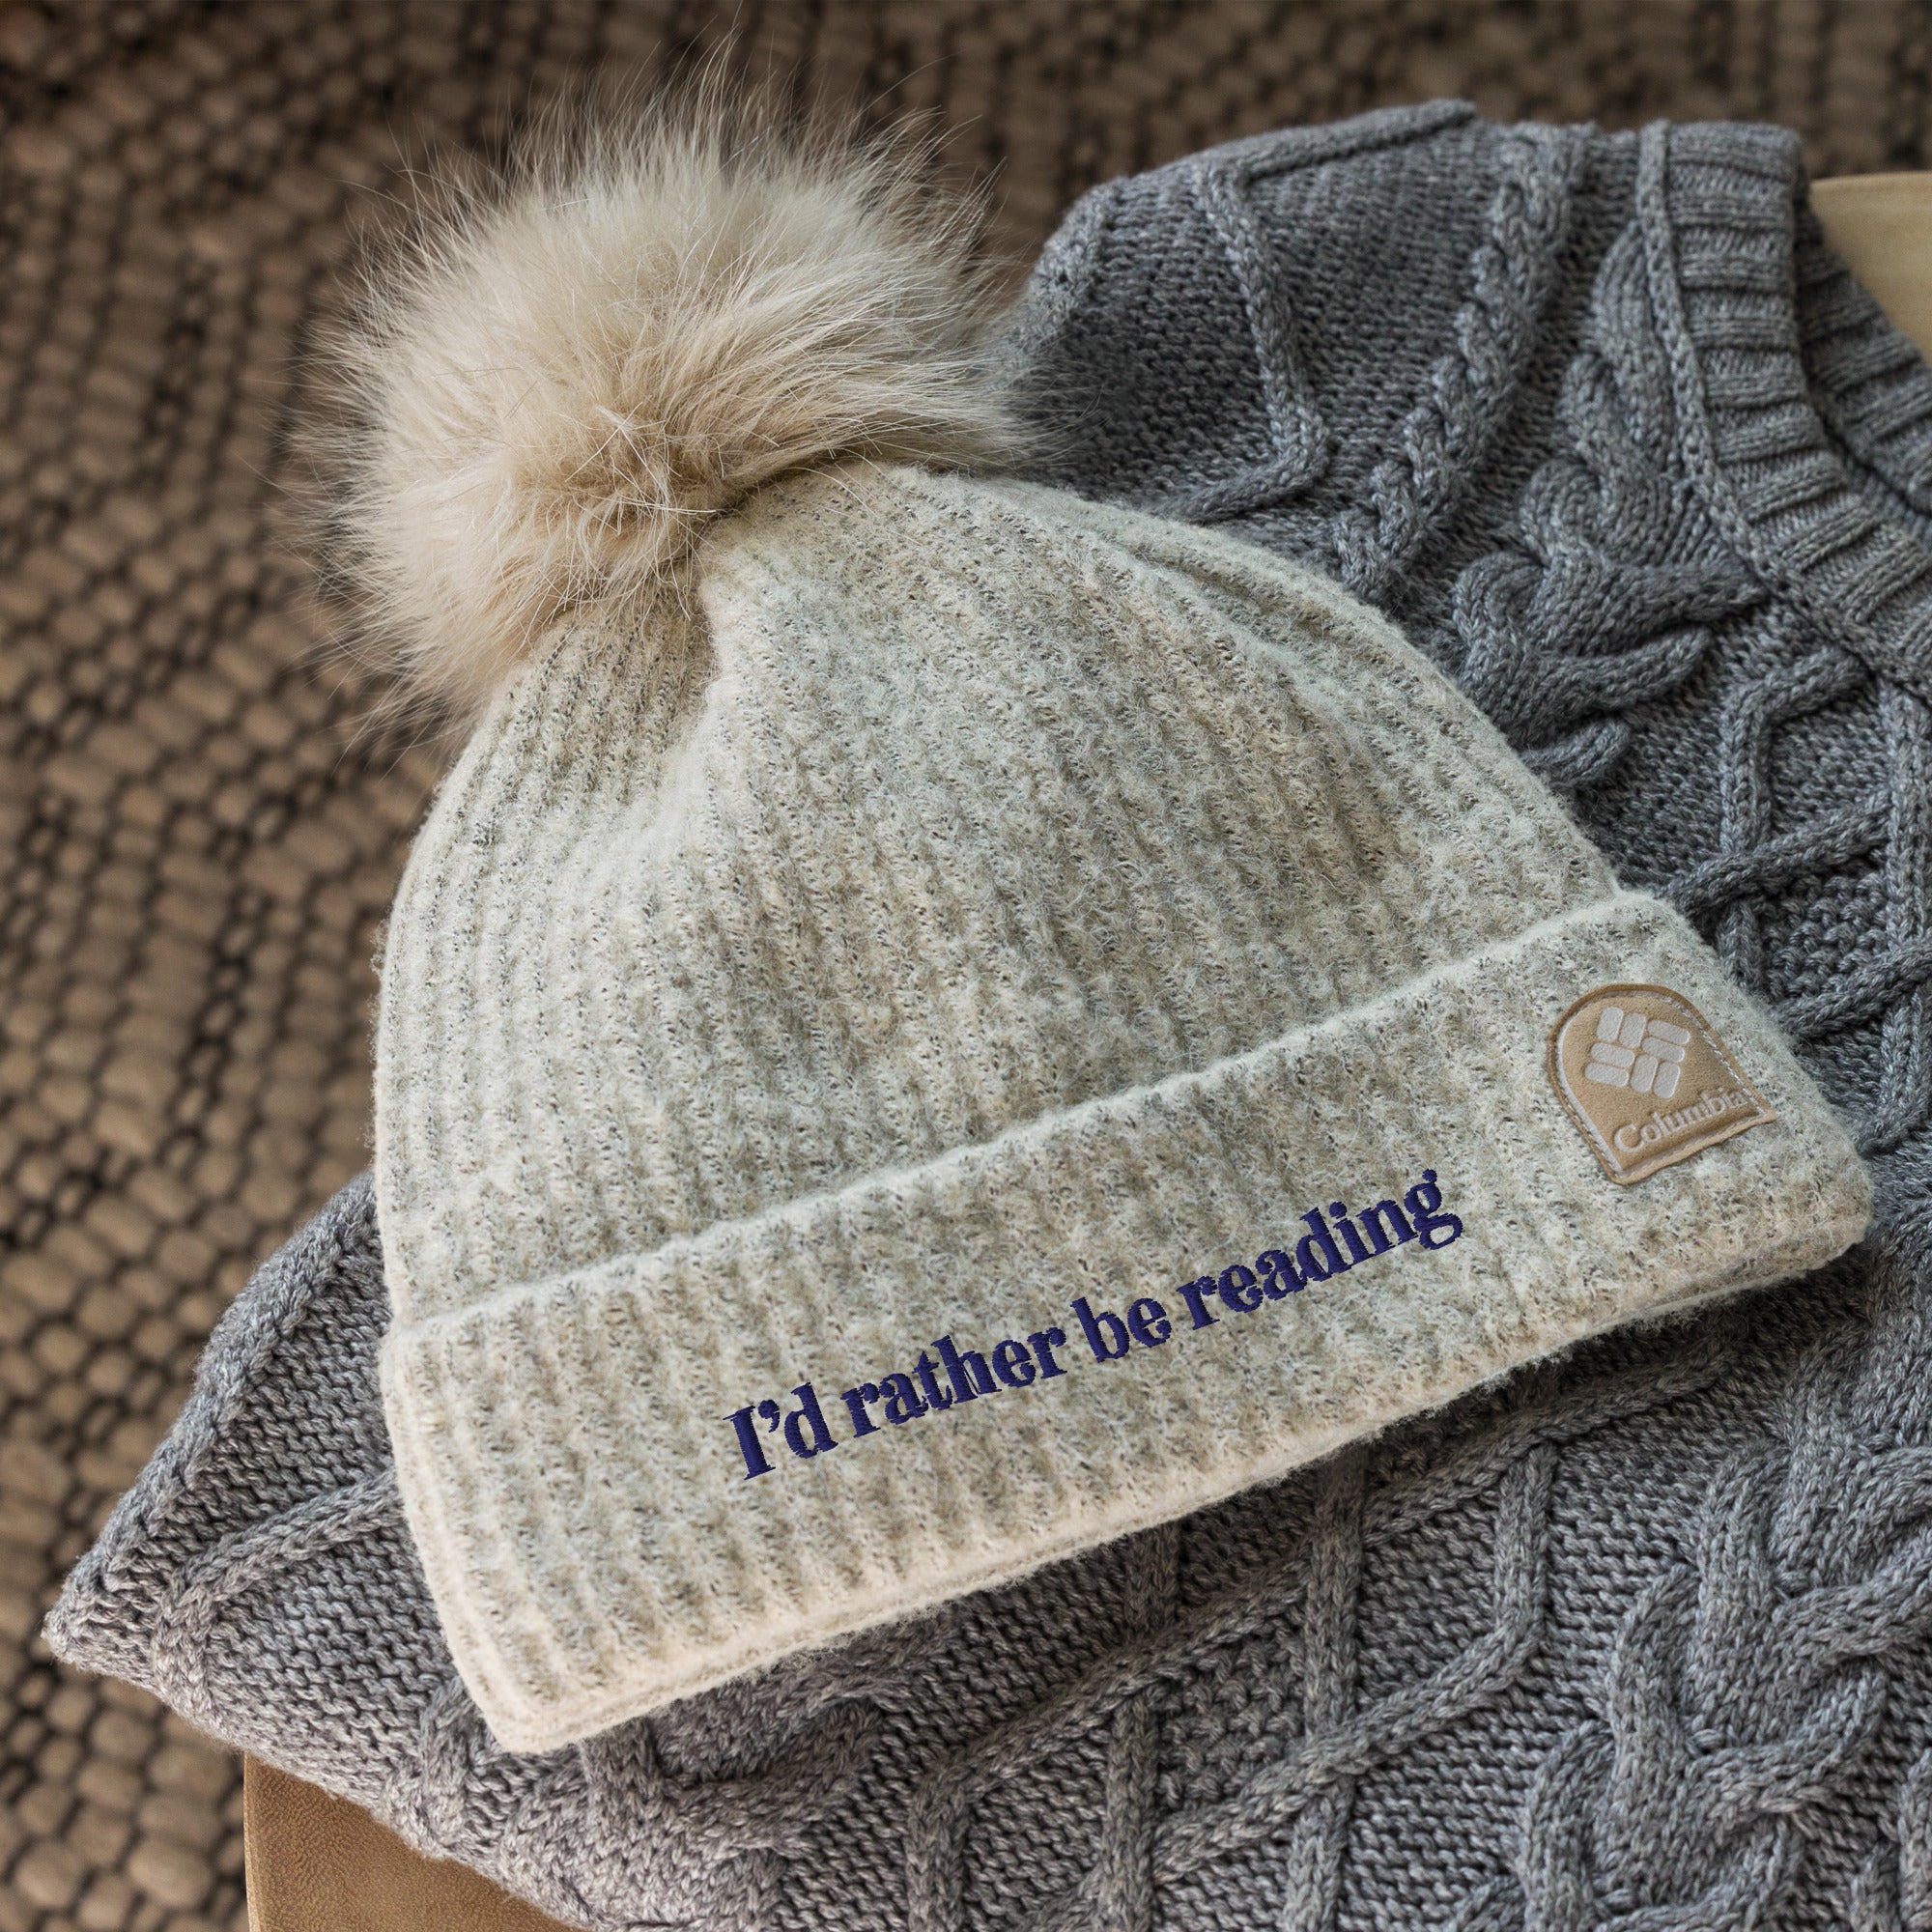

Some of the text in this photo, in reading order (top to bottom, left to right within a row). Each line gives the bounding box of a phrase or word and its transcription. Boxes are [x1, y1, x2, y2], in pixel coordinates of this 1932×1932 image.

[1613, 1087, 1748, 1152] Columbia
[840, 1335, 1066, 1438] rather
[1071, 1296, 1172, 1364] be
[1176, 1168, 1463, 1330] reading
